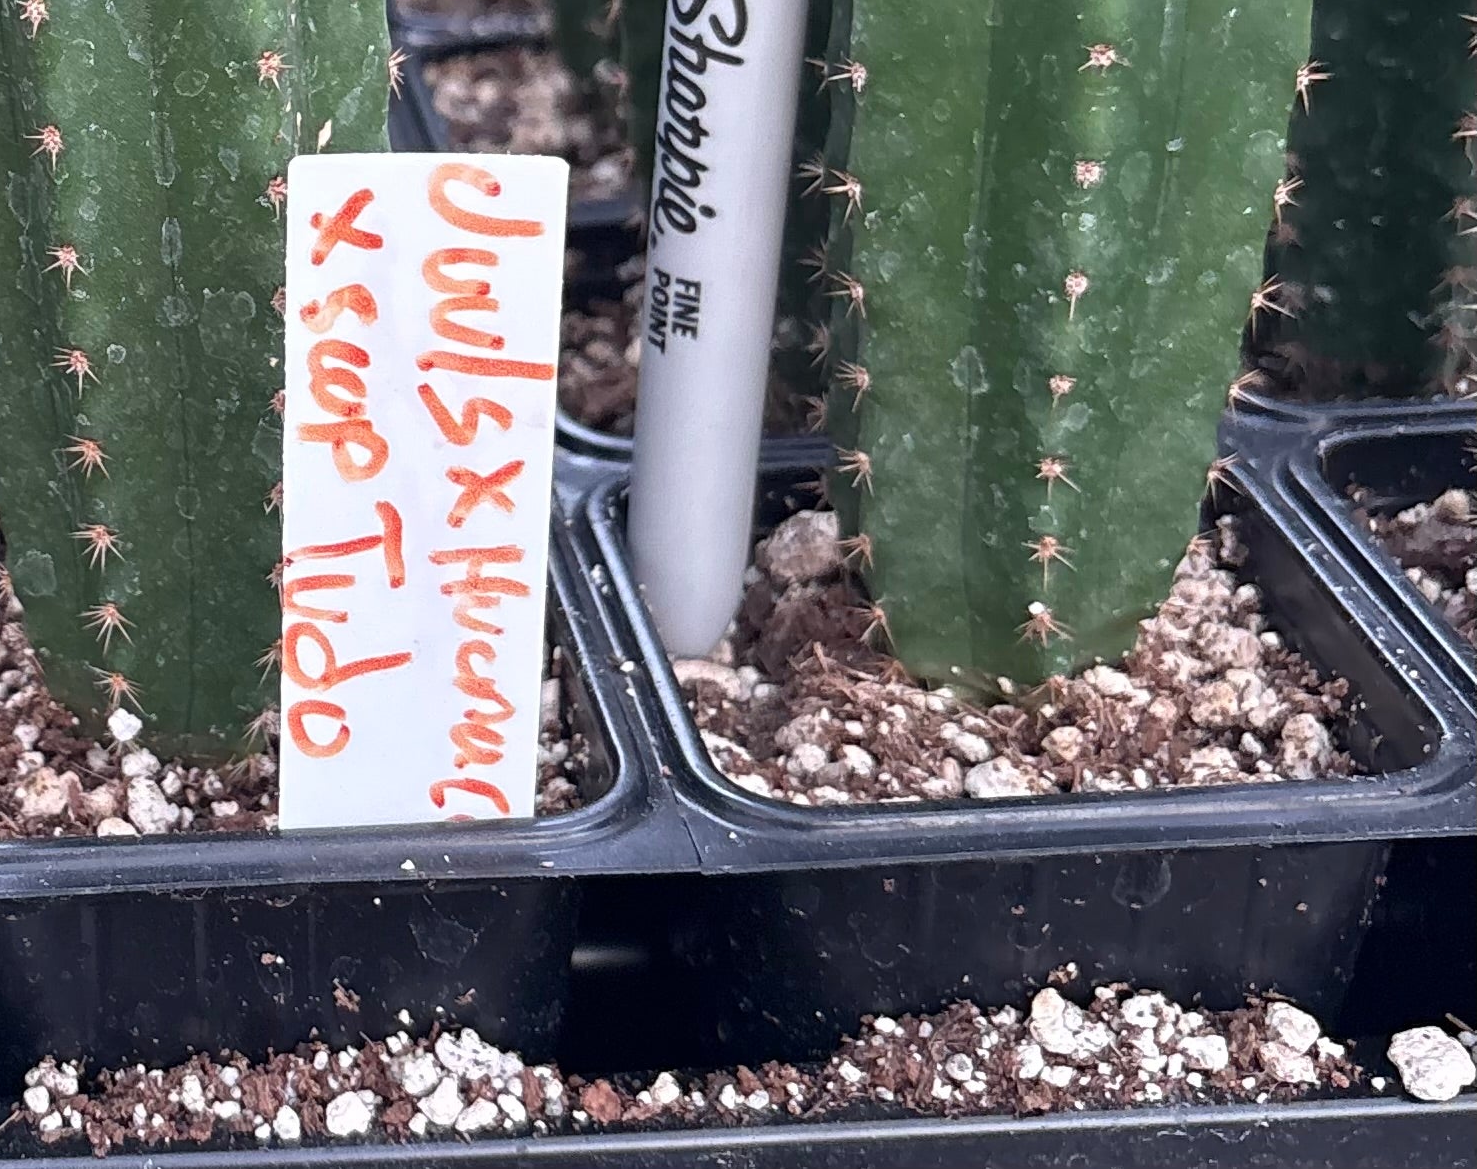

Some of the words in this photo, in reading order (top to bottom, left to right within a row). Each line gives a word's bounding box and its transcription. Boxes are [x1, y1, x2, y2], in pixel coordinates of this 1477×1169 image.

[310, 188, 384, 266] x
[644, 265, 670, 356] POINT
[670, 277, 702, 340] FINE
[283, 500, 414, 758] Tudo
